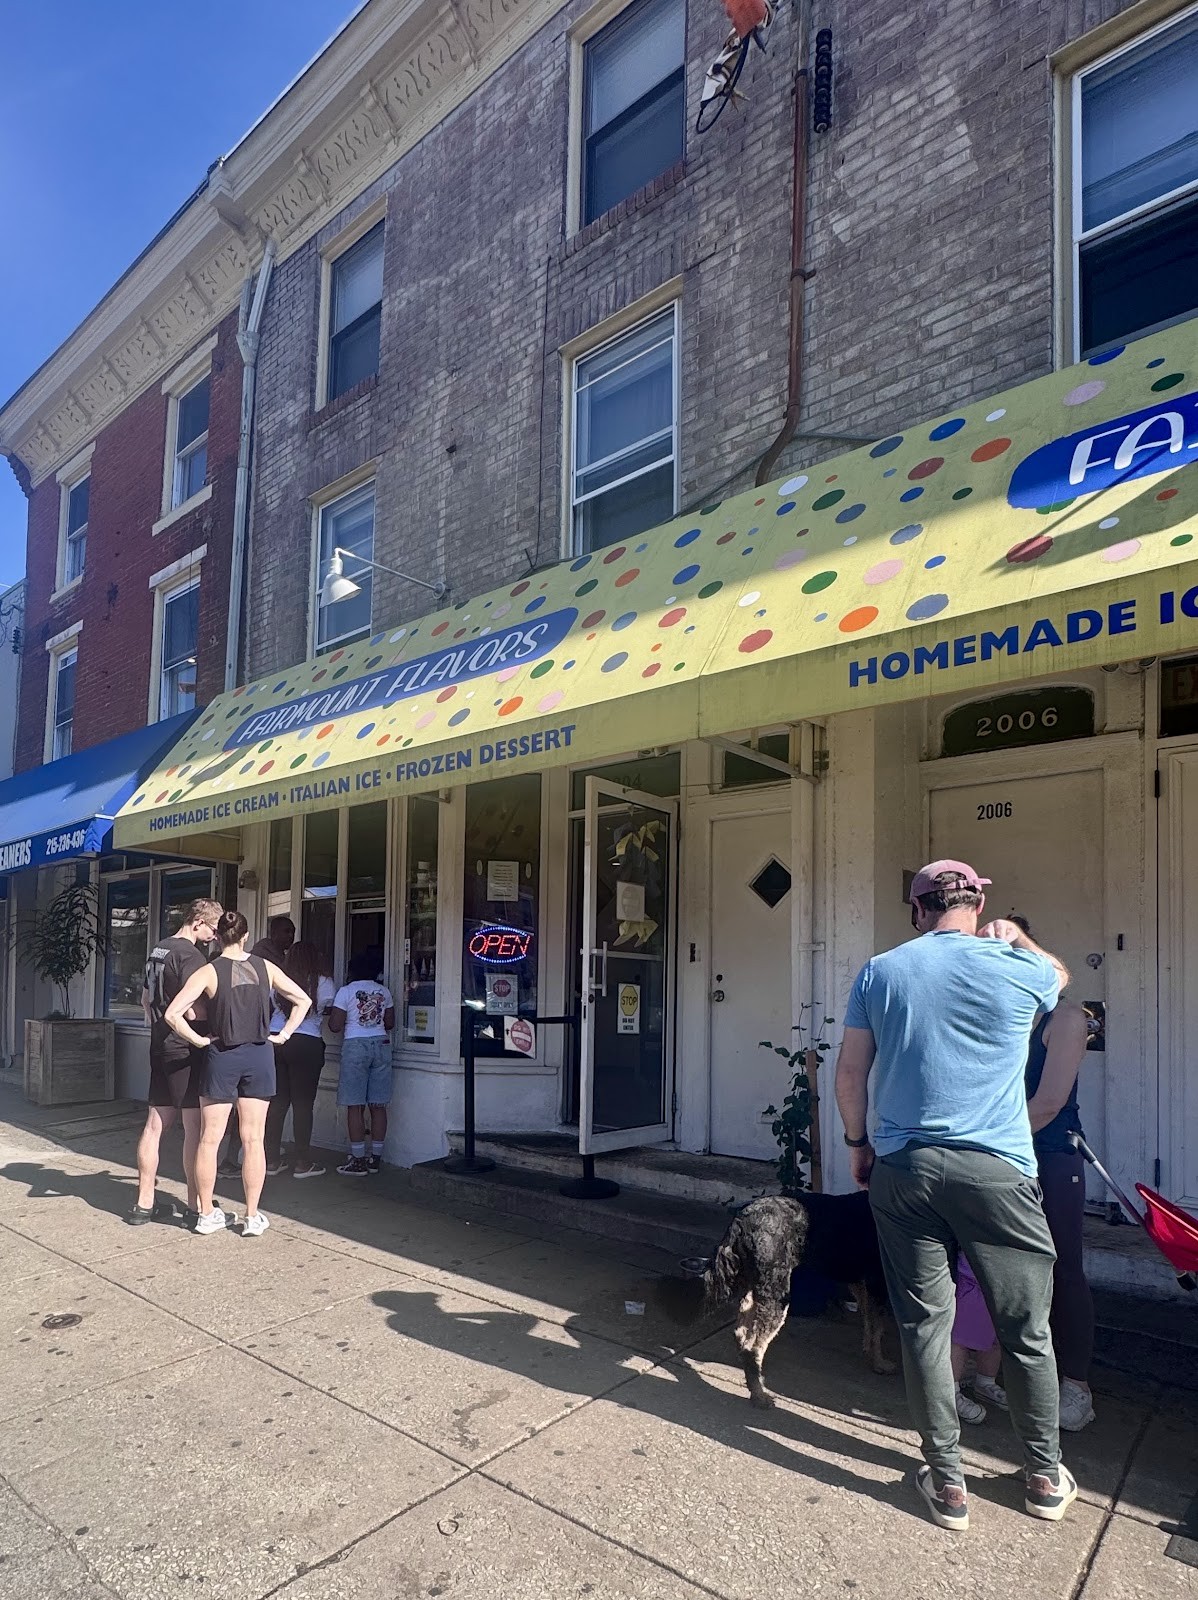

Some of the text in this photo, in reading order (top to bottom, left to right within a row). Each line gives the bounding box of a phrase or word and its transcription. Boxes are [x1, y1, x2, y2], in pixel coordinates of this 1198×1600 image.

[1068, 402, 1198, 486] FA
[849, 599, 1137, 688] HOMEMADE
[237, 622, 549, 744] FAIRMOUNT FLAVORS
[976, 706, 1058, 737] 2006
[149, 724, 576, 832] HOMEMADE ICE CREAM ITALIAN ICE FROZEN DESSERT
[976, 801, 1013, 821] 2006
[469, 934, 531, 956] OPEN
[494, 984, 510, 992] STOP
[621, 995, 638, 1006] STOP
